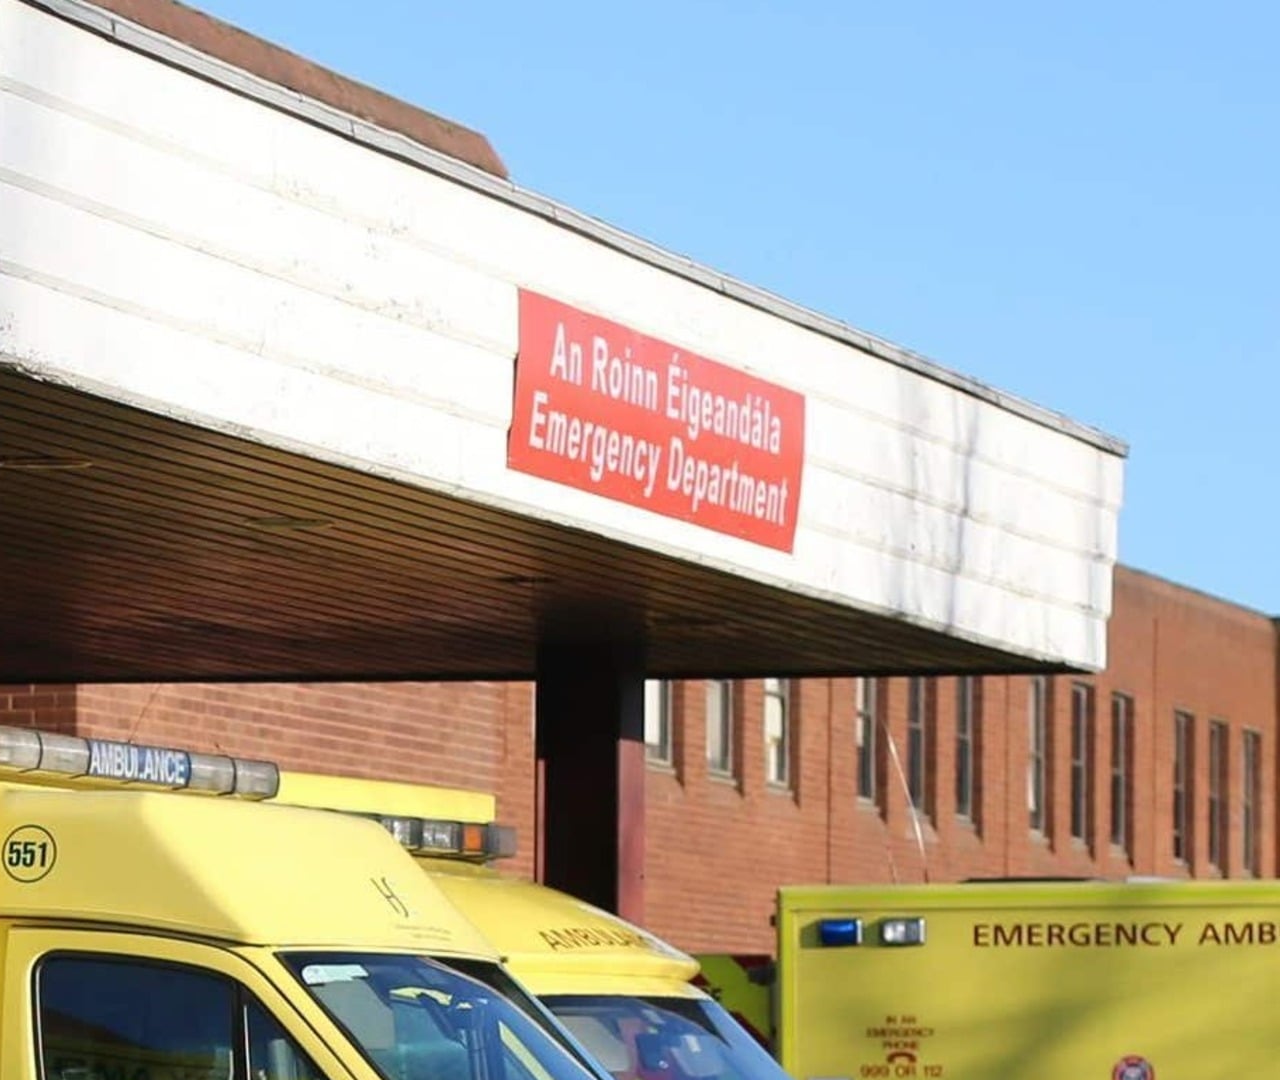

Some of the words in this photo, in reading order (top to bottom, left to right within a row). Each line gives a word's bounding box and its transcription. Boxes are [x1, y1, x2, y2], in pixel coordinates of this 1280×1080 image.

[550, 322, 582, 386] An
[592, 336, 658, 411] Roinn
[666, 352, 782, 454] Éigeandála
[529, 390, 662, 497] Emergency
[667, 437, 789, 526] Department
[89, 741, 187, 785] AMBULANCE
[8, 841, 47, 868] 551
[973, 922, 1183, 947] EMERGENCY
[1198, 922, 1277, 946] AMB
